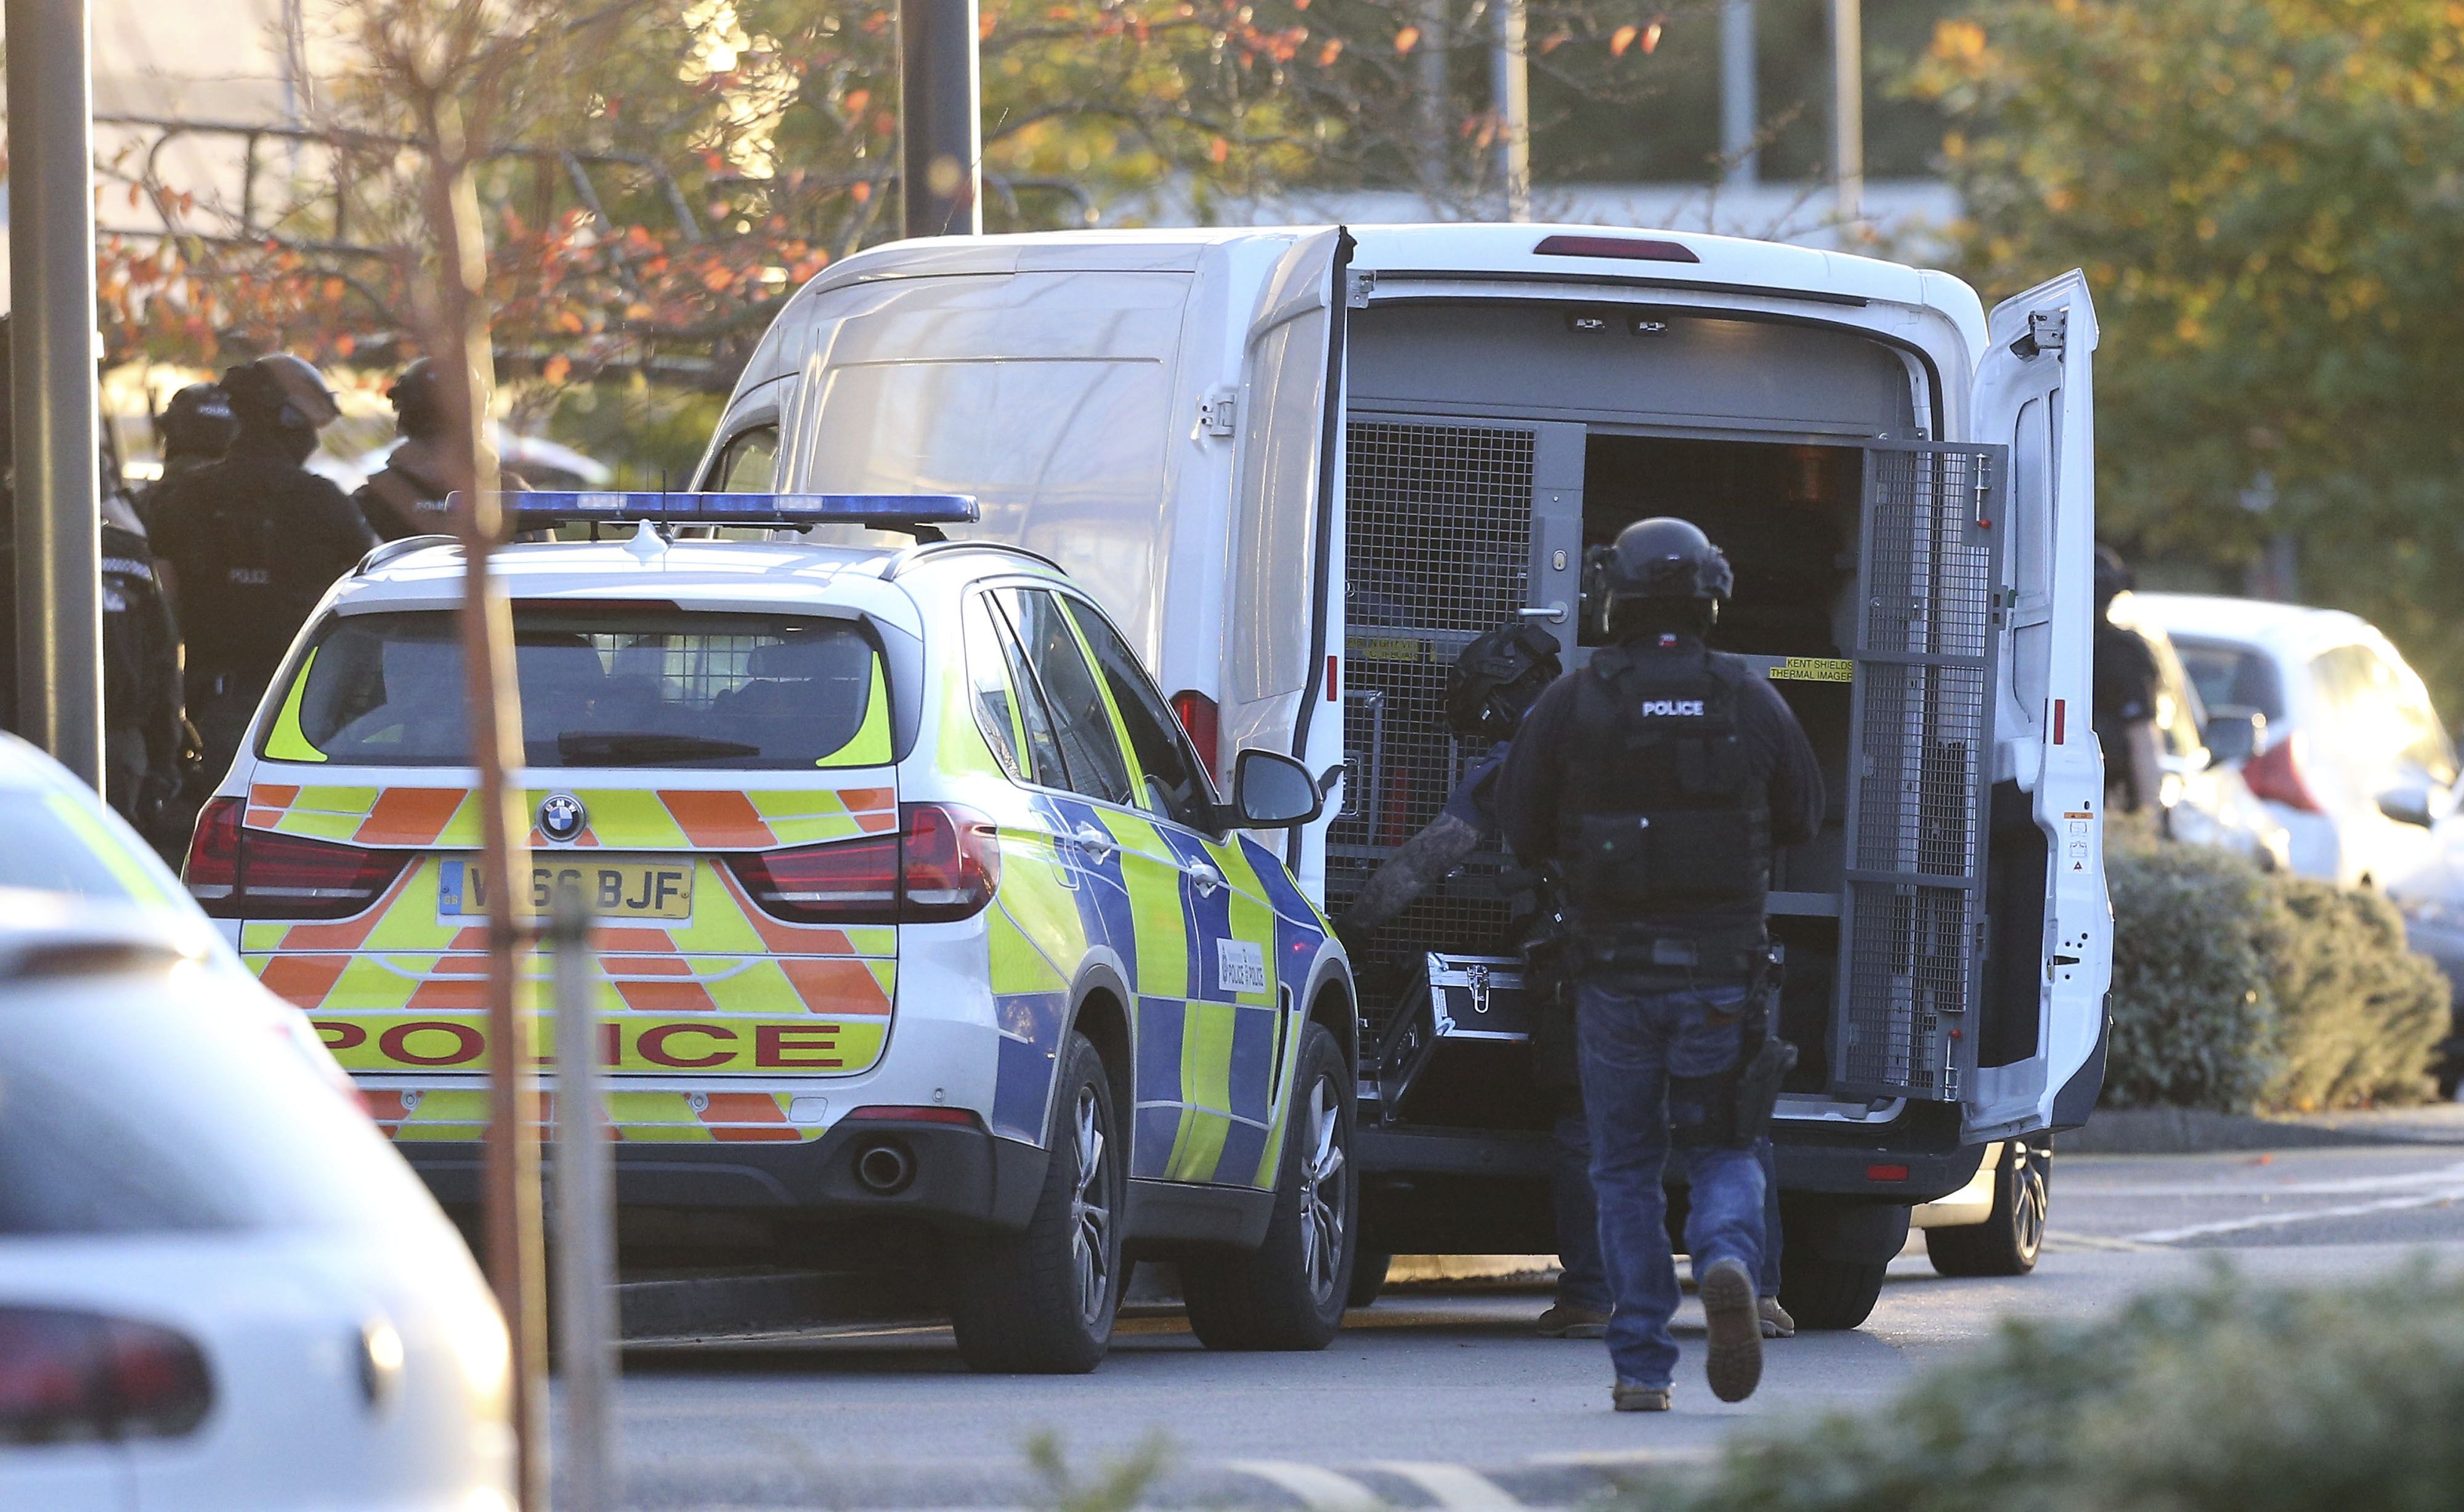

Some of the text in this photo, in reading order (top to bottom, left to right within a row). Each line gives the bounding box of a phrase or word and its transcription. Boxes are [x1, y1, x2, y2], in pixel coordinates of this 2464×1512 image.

[1787, 659, 1812, 668] KENT
[1771, 668, 1815, 679] THERMAL
[1642, 700, 1704, 717] POLICE
[598, 869, 682, 910] BJF
[311, 1021, 843, 1067] POICE
